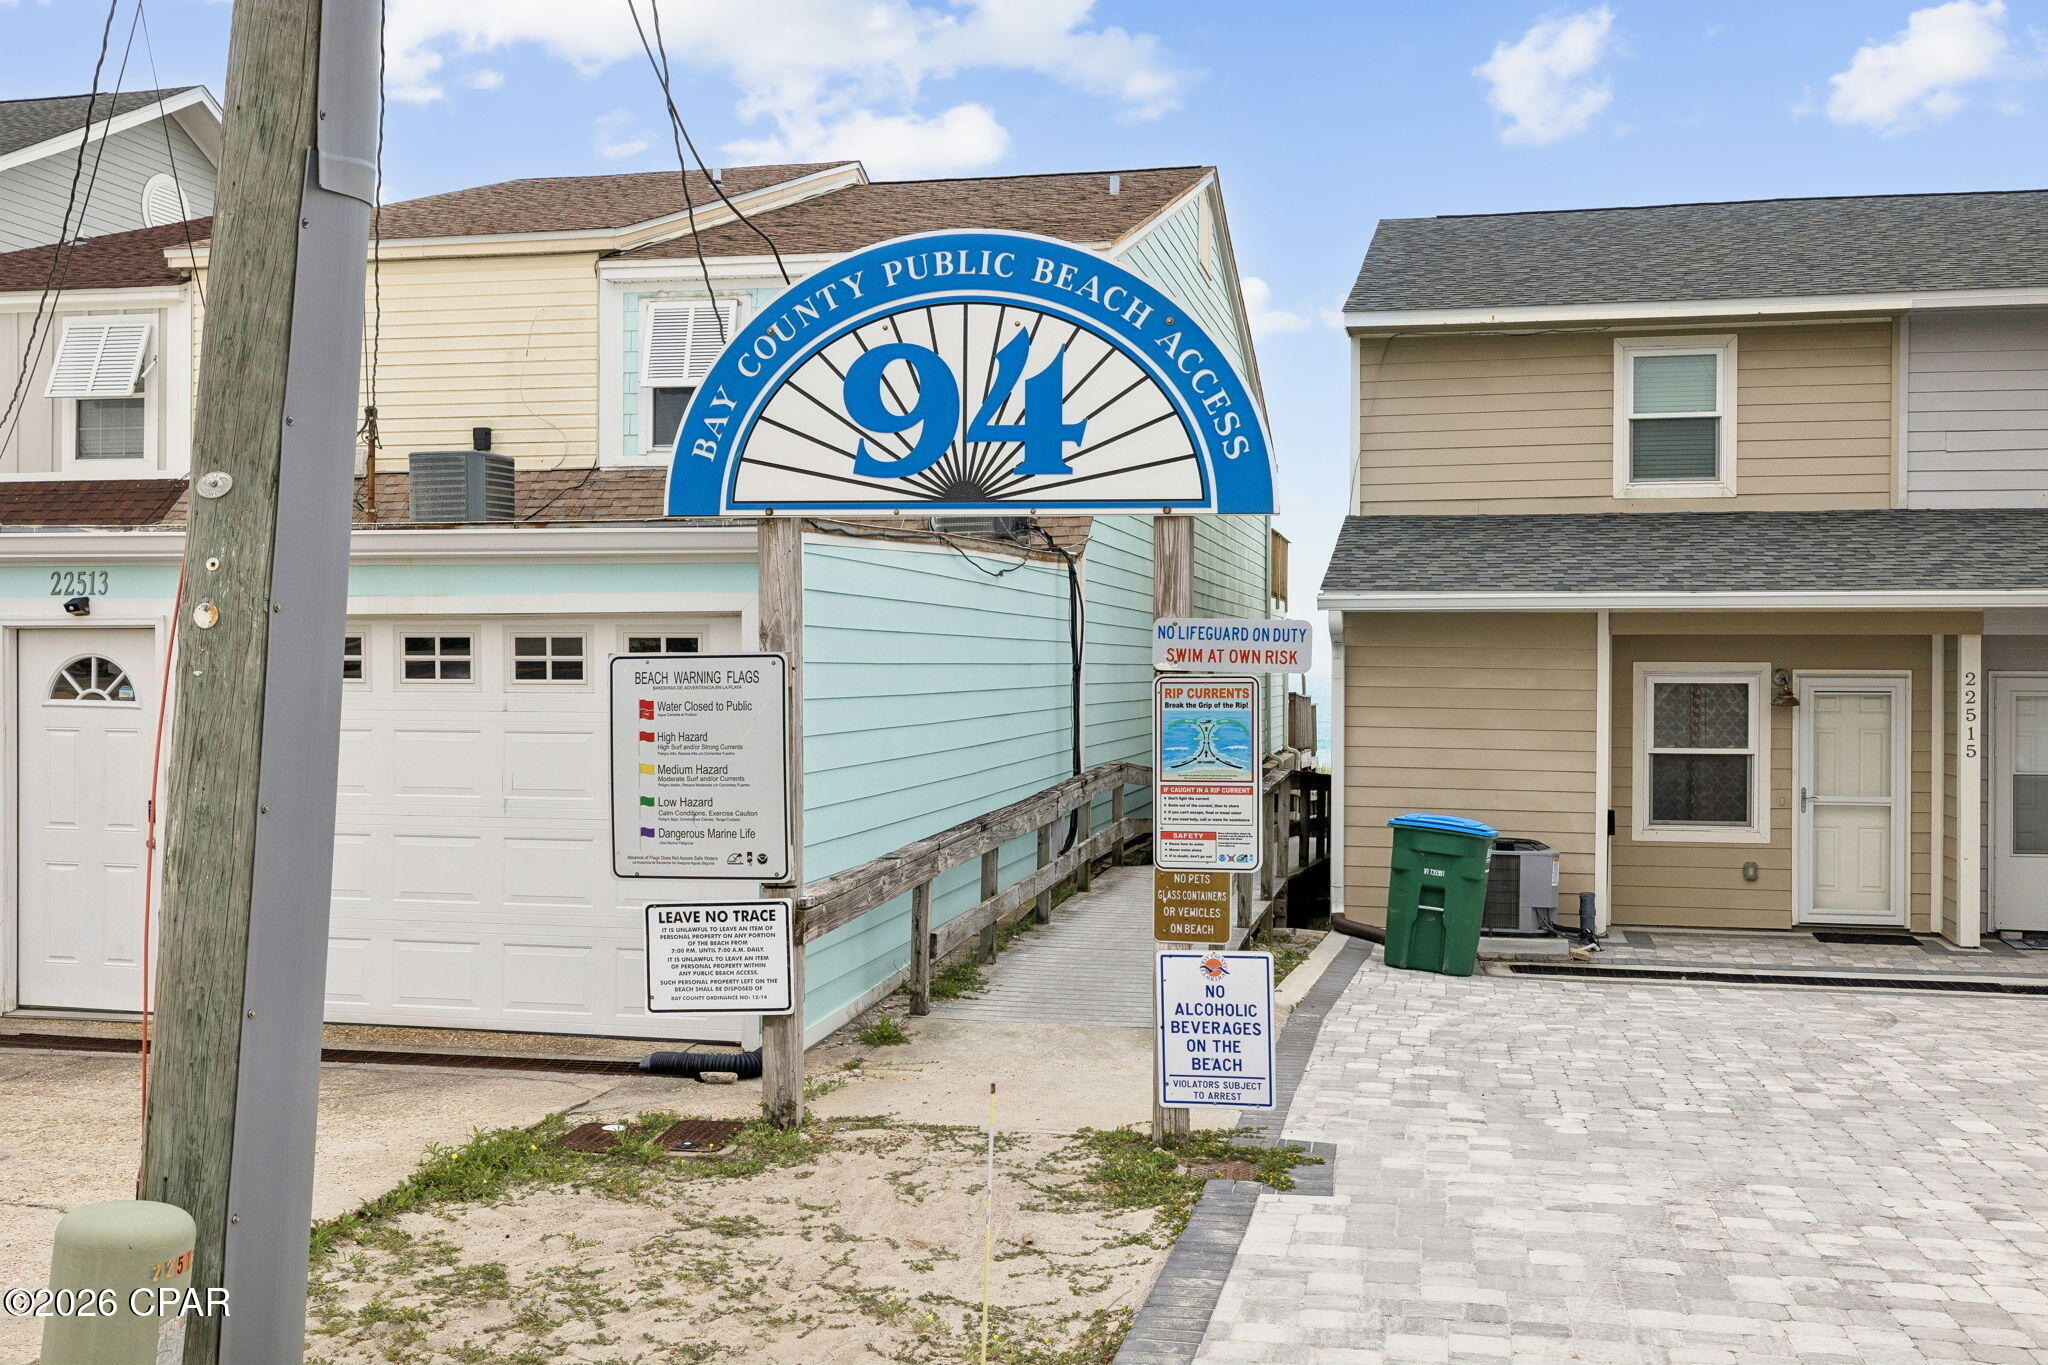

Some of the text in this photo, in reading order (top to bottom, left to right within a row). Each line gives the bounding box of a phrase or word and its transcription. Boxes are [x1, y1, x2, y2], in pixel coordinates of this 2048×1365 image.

[691, 249, 1250, 462] BAY COUNTY PUBLIC BEACH ACCESS
[842, 326, 1088, 478] 94
[50, 570, 108, 595] 22513
[1158, 625, 1307, 643] NO LIFEGUARD ON DUTY
[1166, 648, 1298, 664] SWIM AT OWN RISK
[635, 671, 760, 685] BEACH WARNING FLAGS
[1165, 688, 1249, 698] RIP CURRENTS
[657, 701, 752, 712] Water Closed to Public
[1965, 672, 1976, 758] 22515
[657, 732, 708, 745] High Hazard
[657, 765, 728, 775] Medium Hazard
[658, 797, 713, 807] Low Hazard
[658, 828, 756, 840] Dangerous Marine Life
[1174, 874, 1210, 884] NO PETS
[1158, 890, 1227, 901] GLASS CONTAINERS
[658, 910, 776, 924] LEAVE NO TRACE
[1164, 907, 1221, 918] OR VEHICLES
[1170, 924, 1214, 934] ON BEACH
[1205, 985, 1225, 998] NO
[1175, 1003, 1257, 1017] ALCOHOLIC
[1171, 1021, 1261, 1036] BEVERAGES
[1187, 1039, 1241, 1053] ON THE
[1192, 1058, 1242, 1071] BEACH
[1173, 1080, 1262, 1090] VIOLATORS SUBJECT
[1193, 1091, 1241, 1101] TO ARREST
